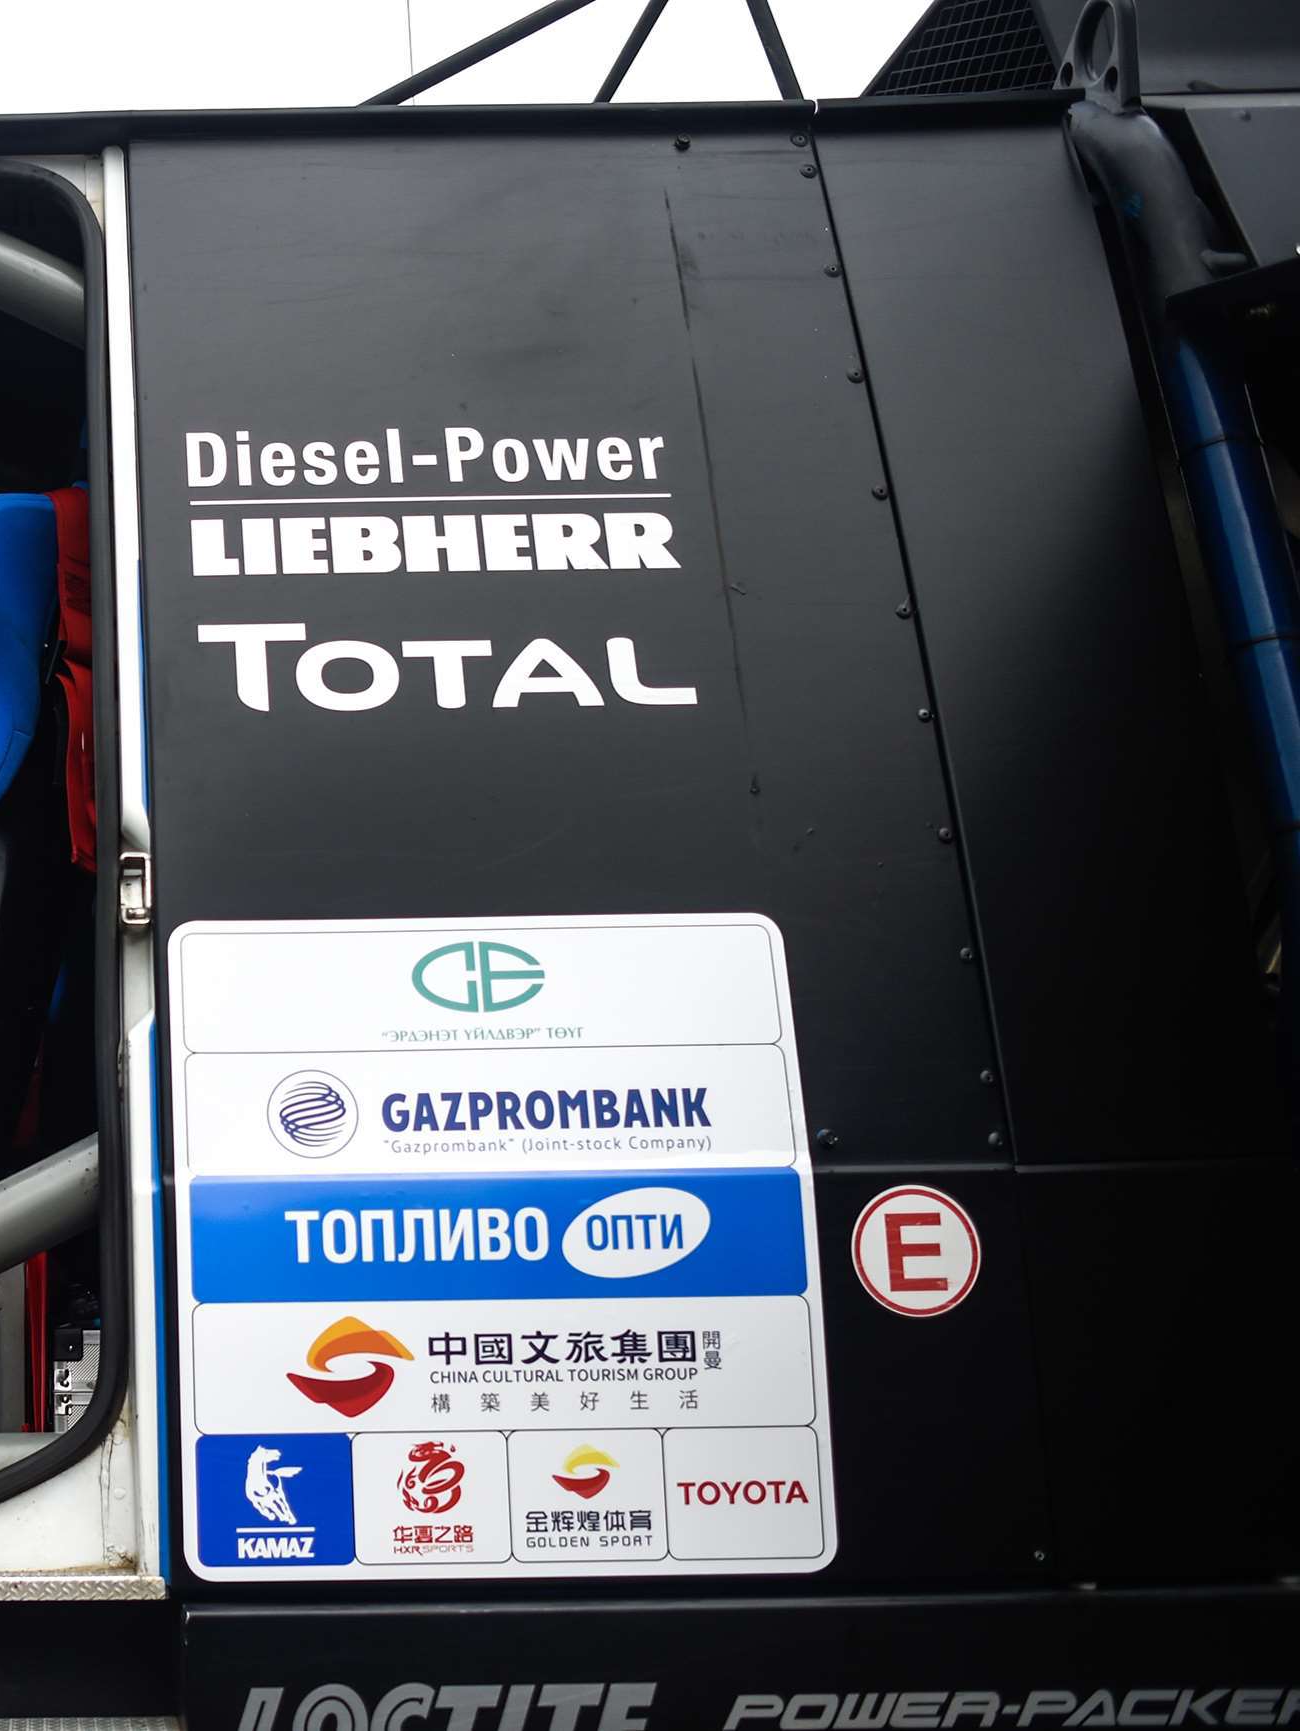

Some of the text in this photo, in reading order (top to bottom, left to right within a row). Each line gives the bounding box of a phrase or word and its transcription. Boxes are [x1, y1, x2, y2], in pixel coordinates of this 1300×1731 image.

[185, 426, 664, 488] Diesel-Power
[190, 512, 682, 577] LIEBHERR
[197, 622, 698, 712] TOTAL
[381, 1087, 712, 1133] GAZPROMBANK
[383, 1135, 712, 1155] "Gazprombank" (Joint-stock Company)
[284, 1206, 685, 1264] ТОПЛИВО ОПТИ
[884, 1212, 949, 1293] E
[428, 1329, 697, 1366] 中國文旅集團
[702, 1330, 722, 1370] 開曼
[430, 1367, 698, 1384] CHINA CULTURAL TOURISM GROUP
[677, 1480, 809, 1506] TOYOTA
[525, 1510, 652, 1533] 金辉煌体育
[238, 1536, 315, 1559] KAMAZ
[526, 1535, 653, 1548] GOLDEN SPORT
